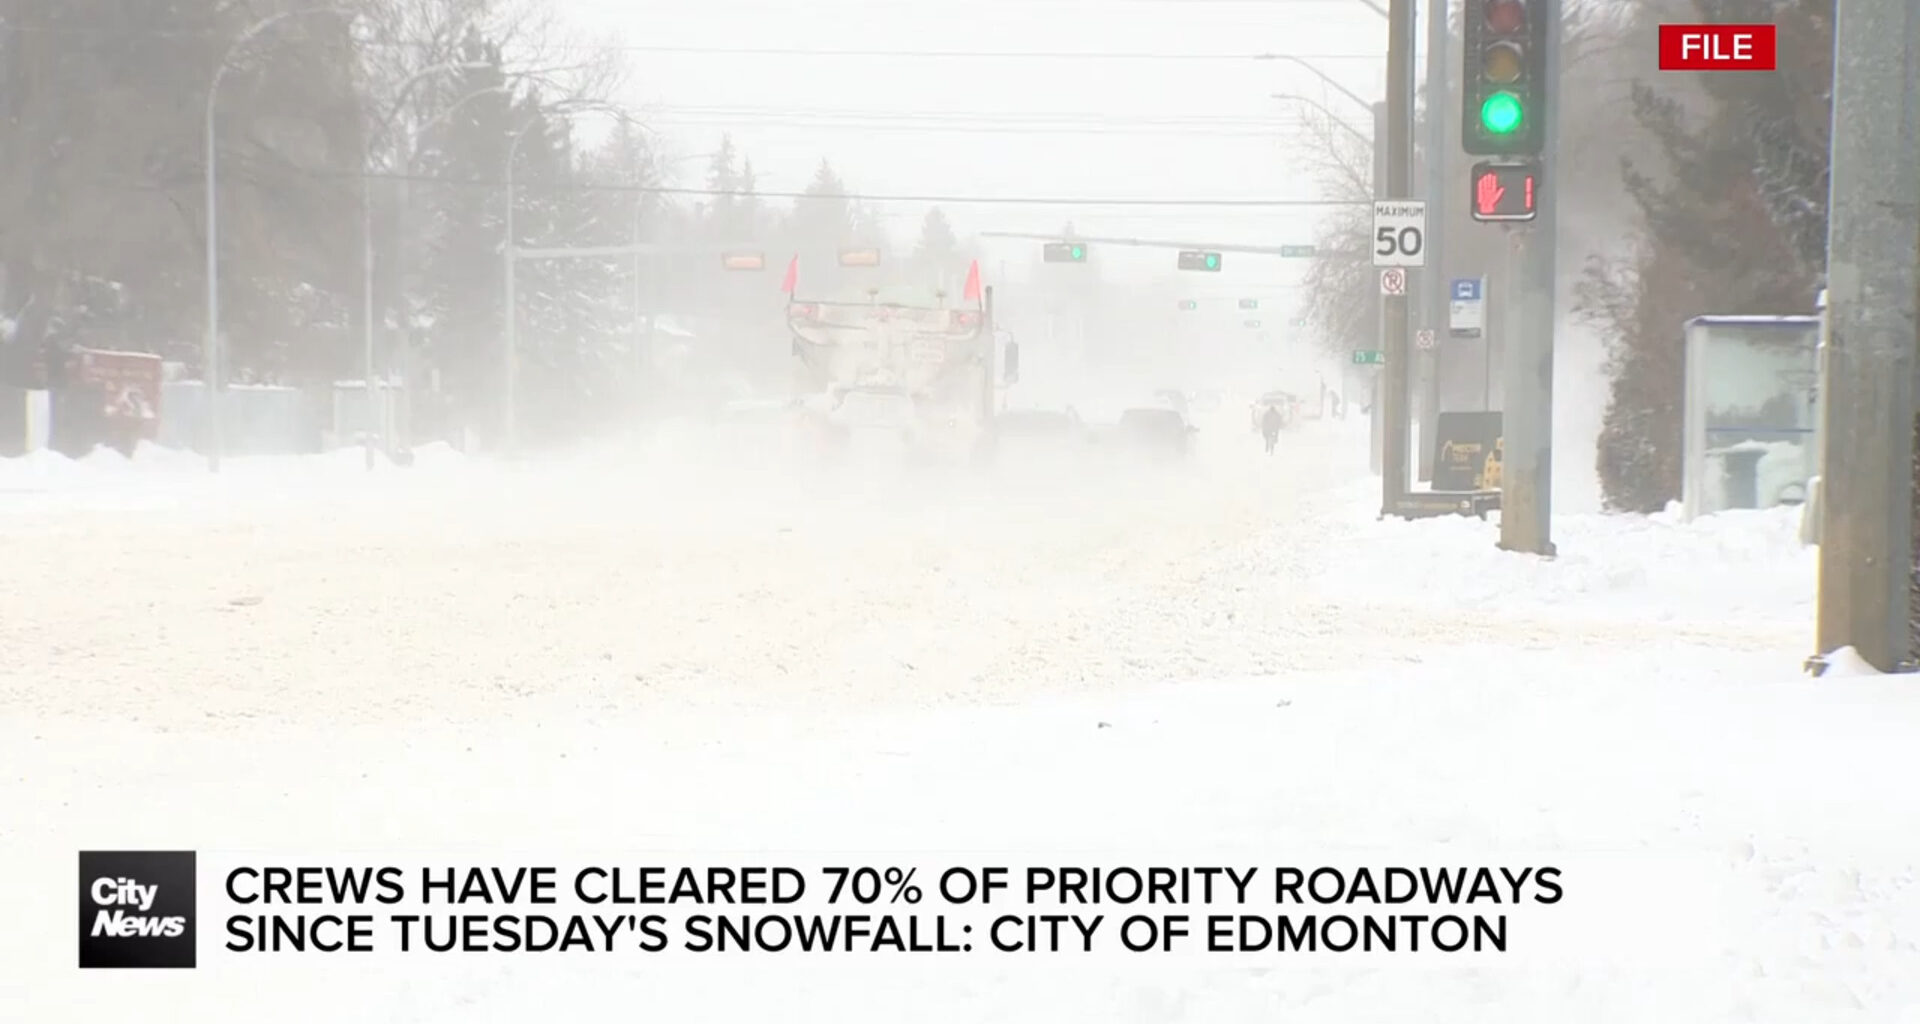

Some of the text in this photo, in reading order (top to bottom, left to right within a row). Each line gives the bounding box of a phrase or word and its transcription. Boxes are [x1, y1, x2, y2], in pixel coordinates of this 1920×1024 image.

[1525, 176, 1534, 209] 1
[1376, 206, 1424, 217] MAXIMUM
[1376, 226, 1422, 256] 50
